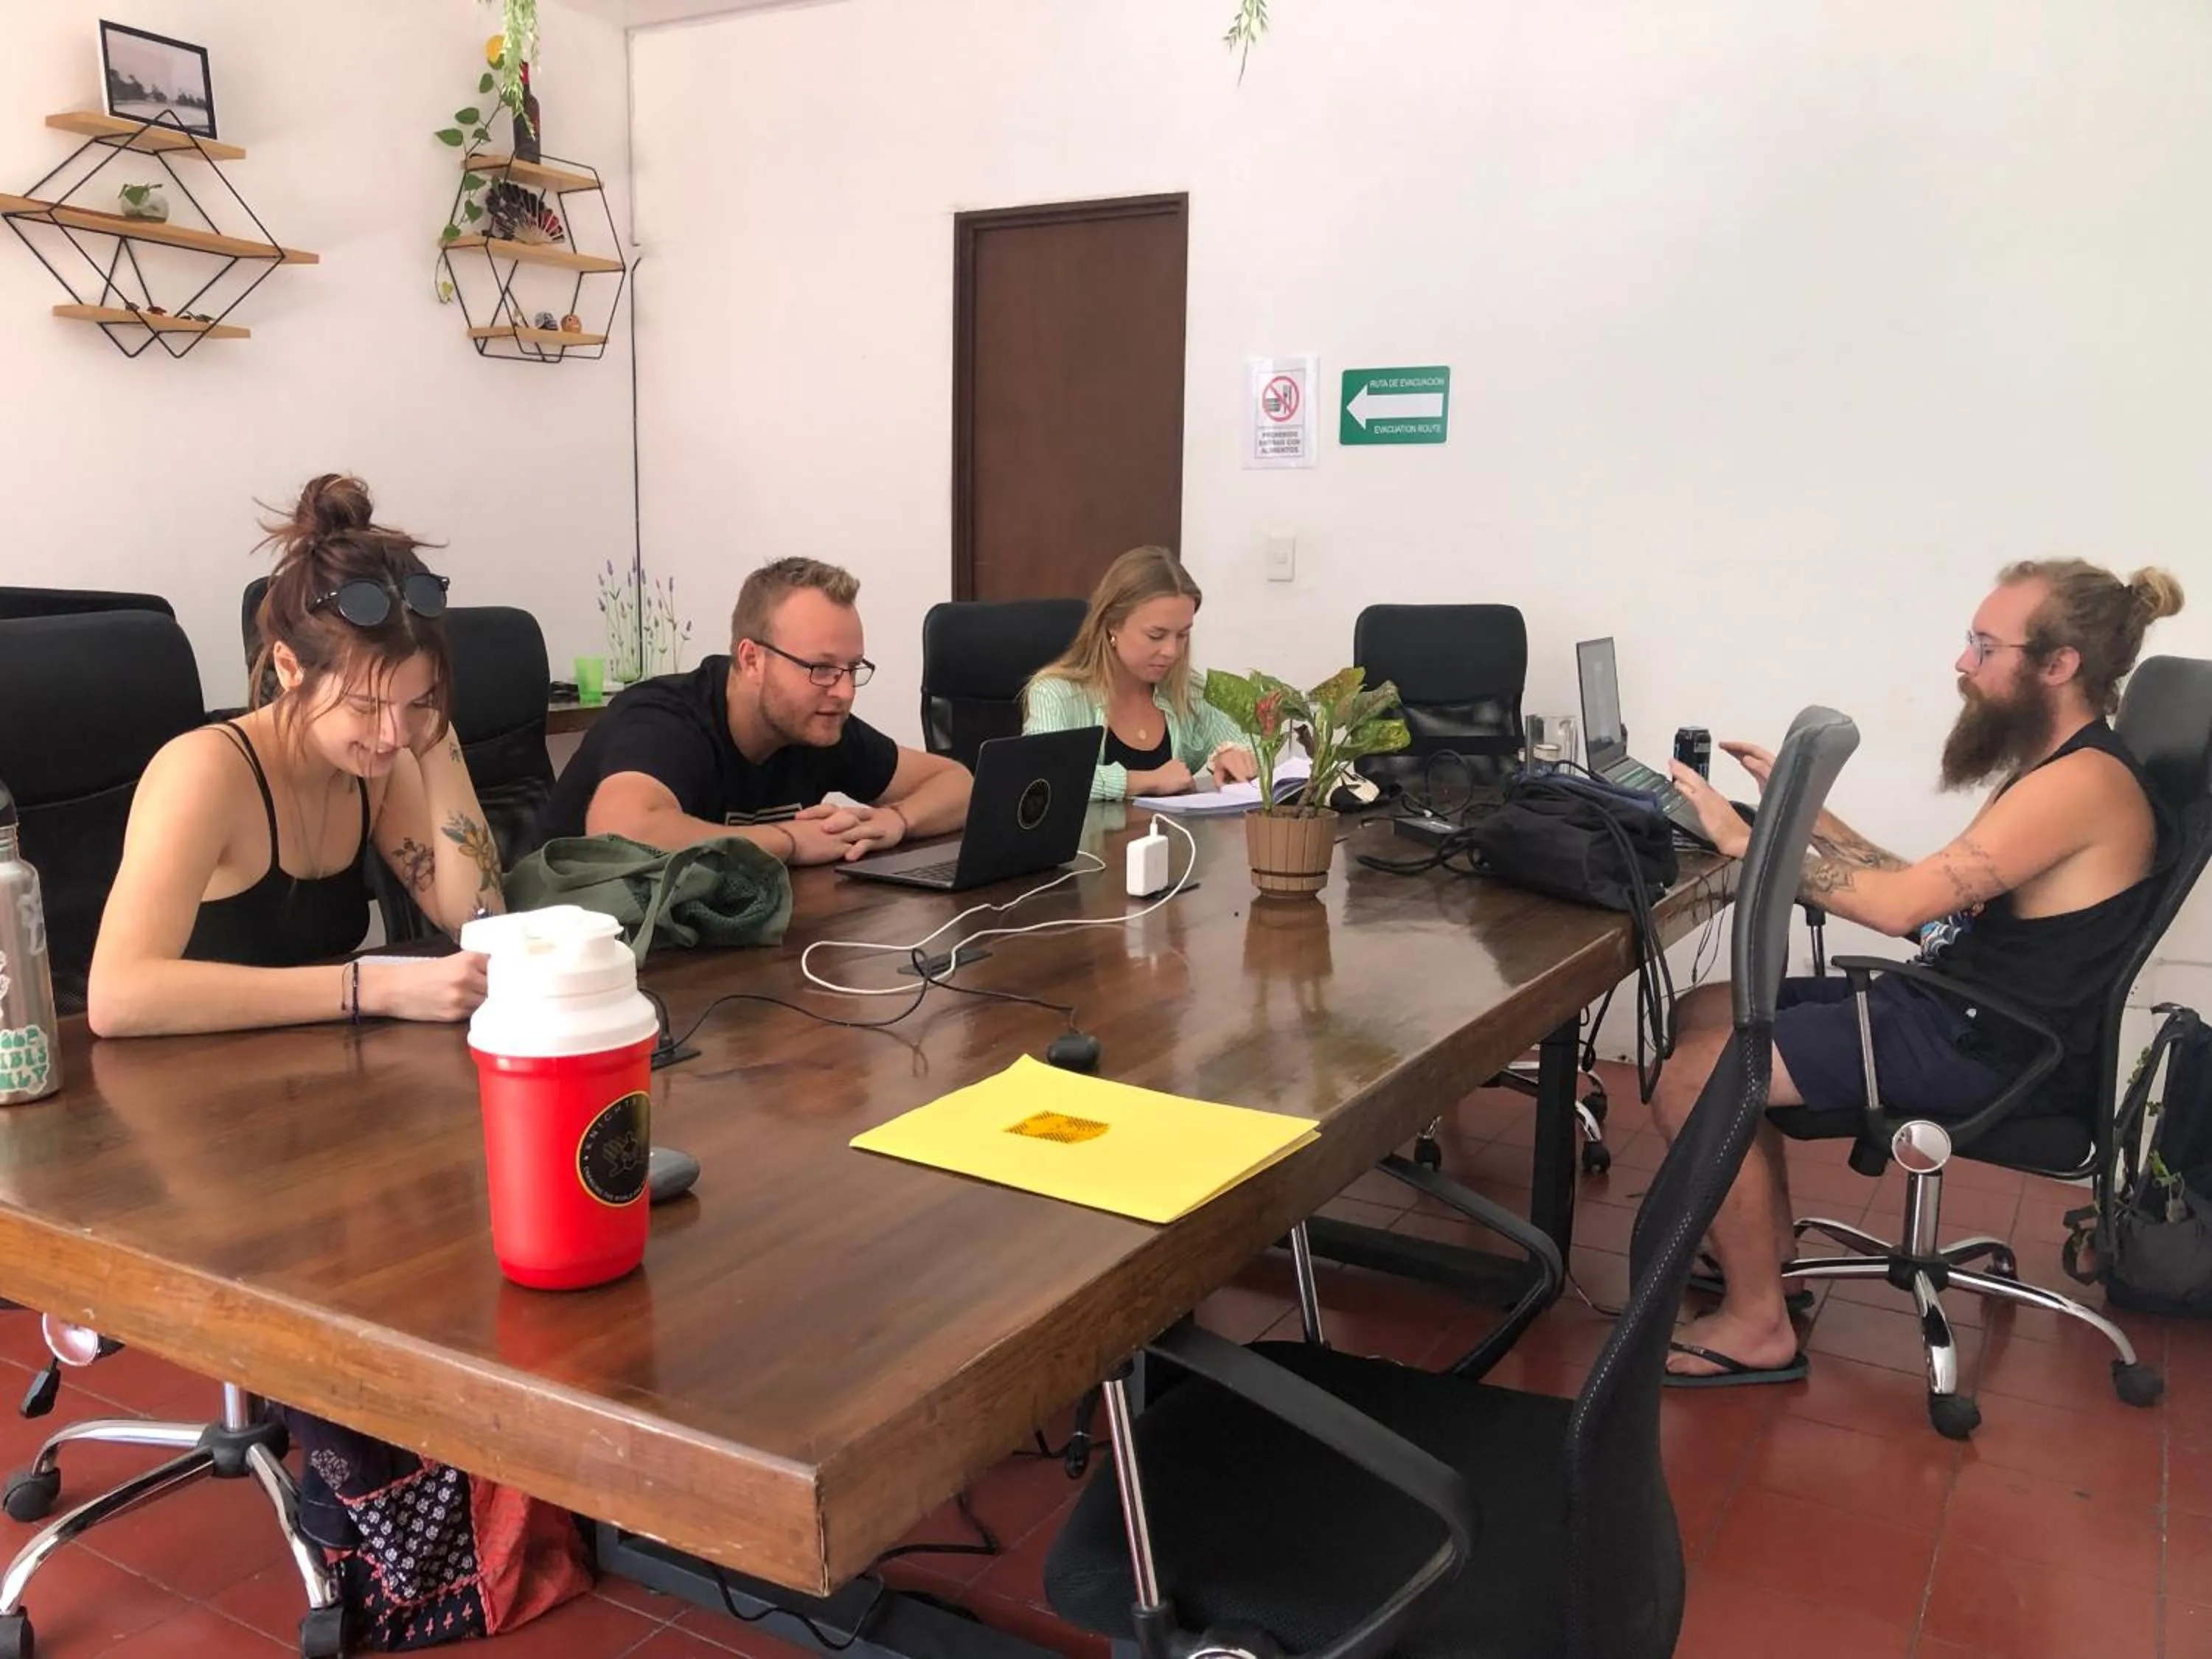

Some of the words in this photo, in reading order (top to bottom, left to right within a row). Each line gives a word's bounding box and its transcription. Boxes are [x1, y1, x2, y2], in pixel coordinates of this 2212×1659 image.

[1369, 380, 1388, 389] RUTA
[1389, 378, 1399, 388] DE
[1374, 424, 1416, 434] EVACUATION
[1418, 424, 1441, 434] ROUTE
